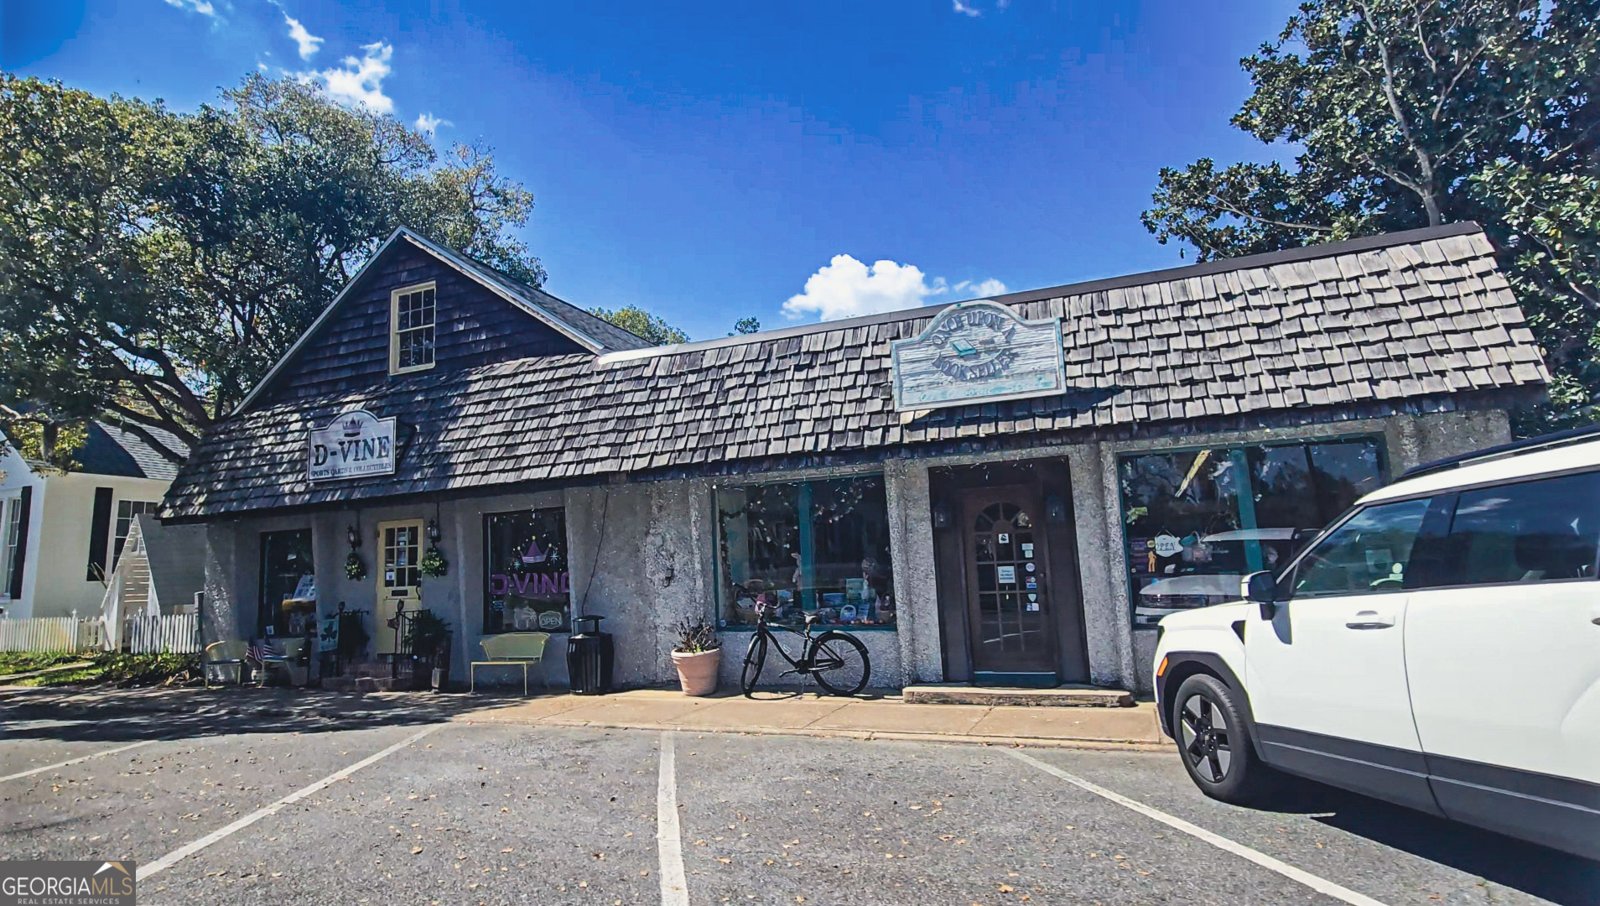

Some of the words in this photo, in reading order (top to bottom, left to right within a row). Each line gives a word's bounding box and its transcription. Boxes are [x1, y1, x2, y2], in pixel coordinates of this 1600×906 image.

[966, 311, 1003, 331] UPON
[313, 435, 390, 467] D-VINE
[541, 616, 562, 626] OPEN
